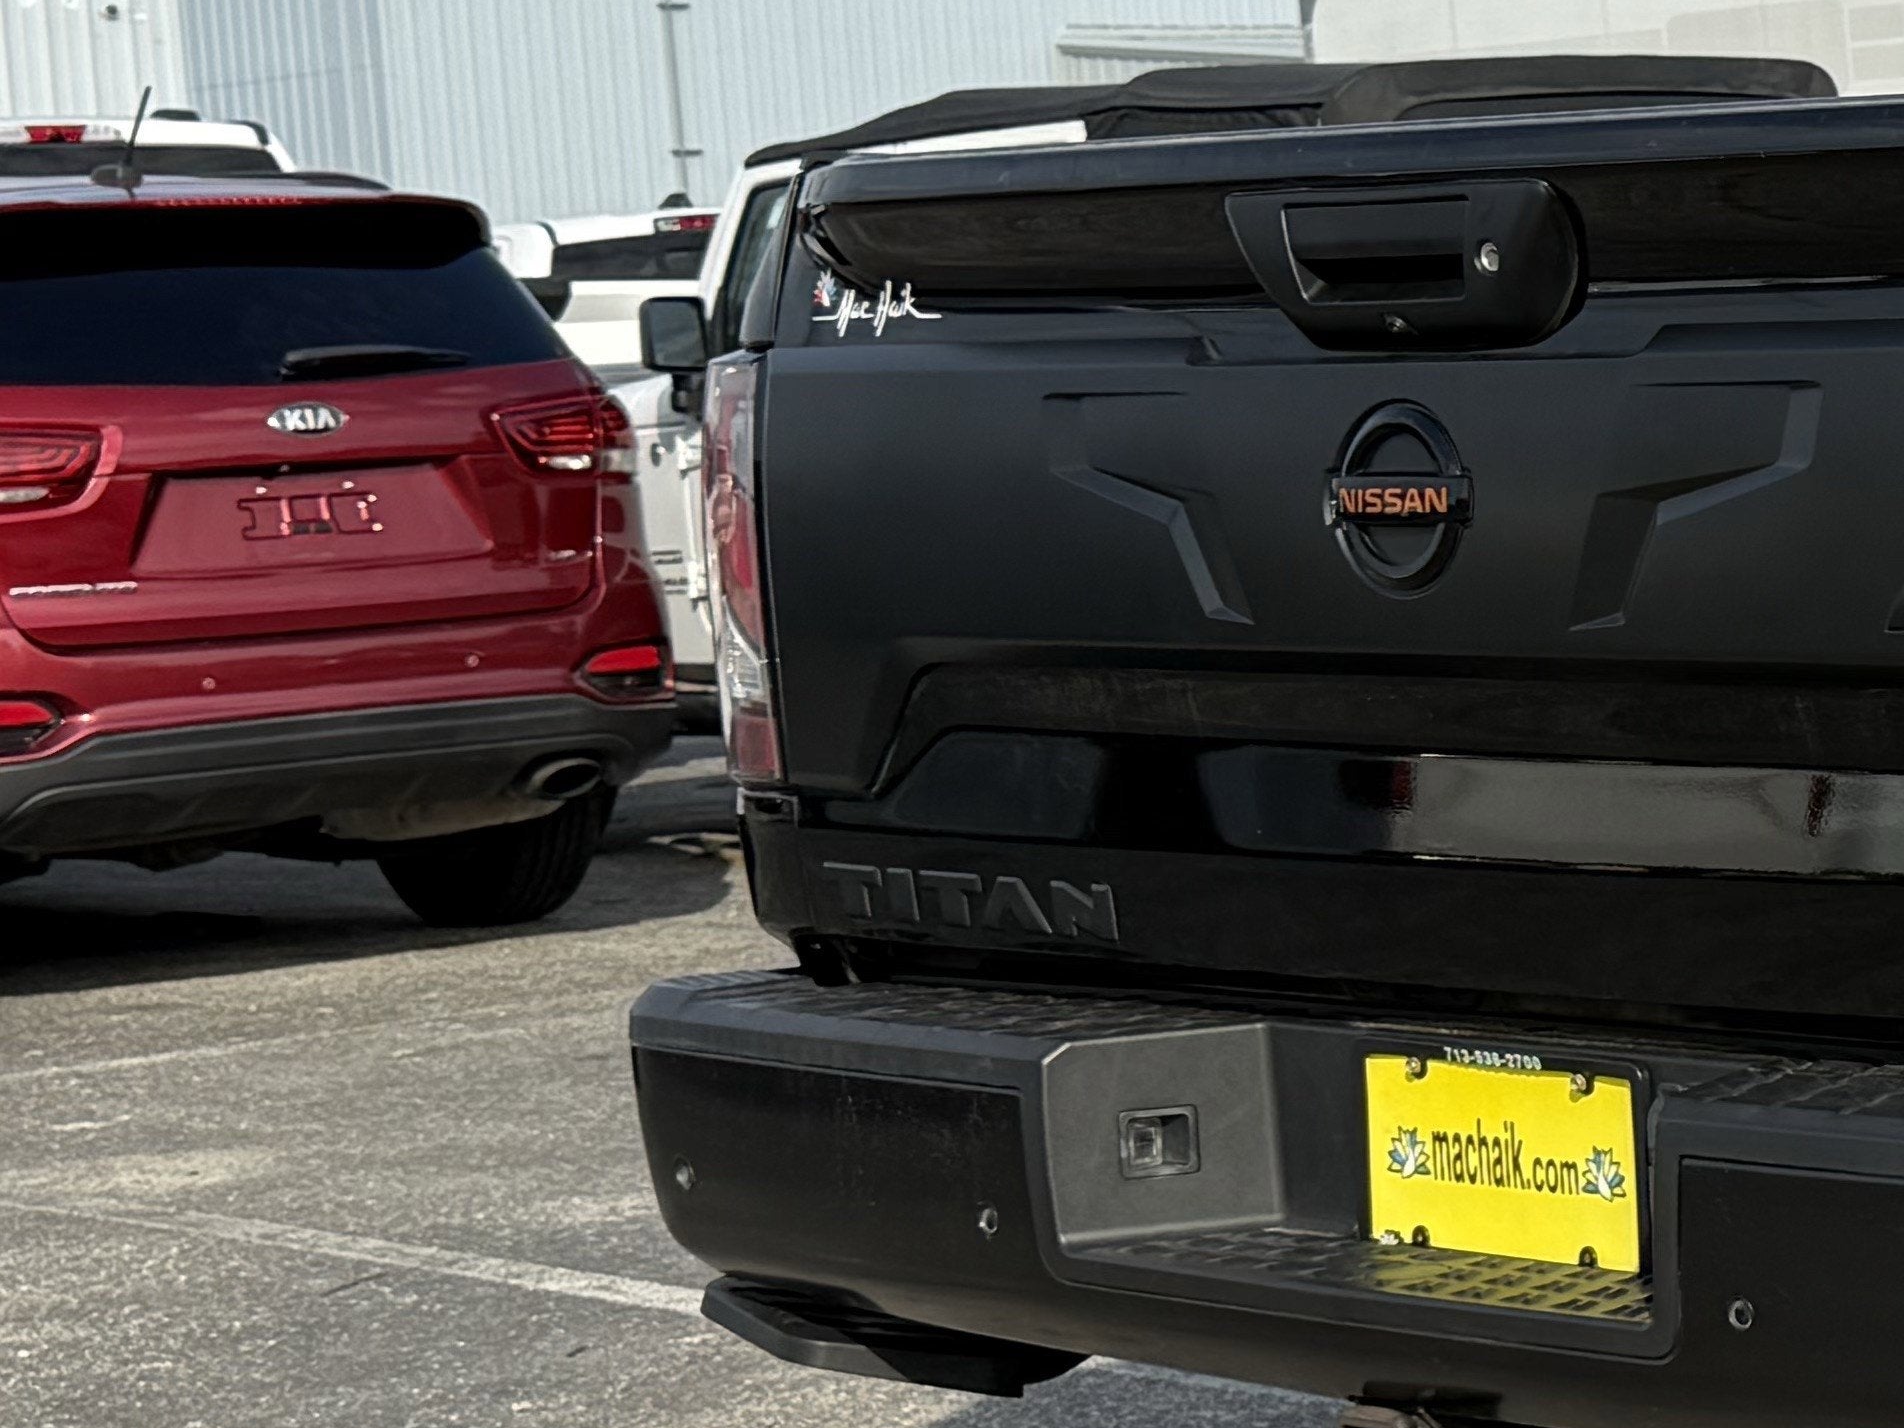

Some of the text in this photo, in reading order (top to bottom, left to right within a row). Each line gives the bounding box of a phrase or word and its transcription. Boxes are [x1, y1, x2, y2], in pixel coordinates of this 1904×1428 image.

[283, 407, 337, 431] KIA
[1338, 486, 1449, 515] NISSAN
[821, 860, 1120, 945] TITAN
[1431, 1117, 1581, 1196] machaik.com
